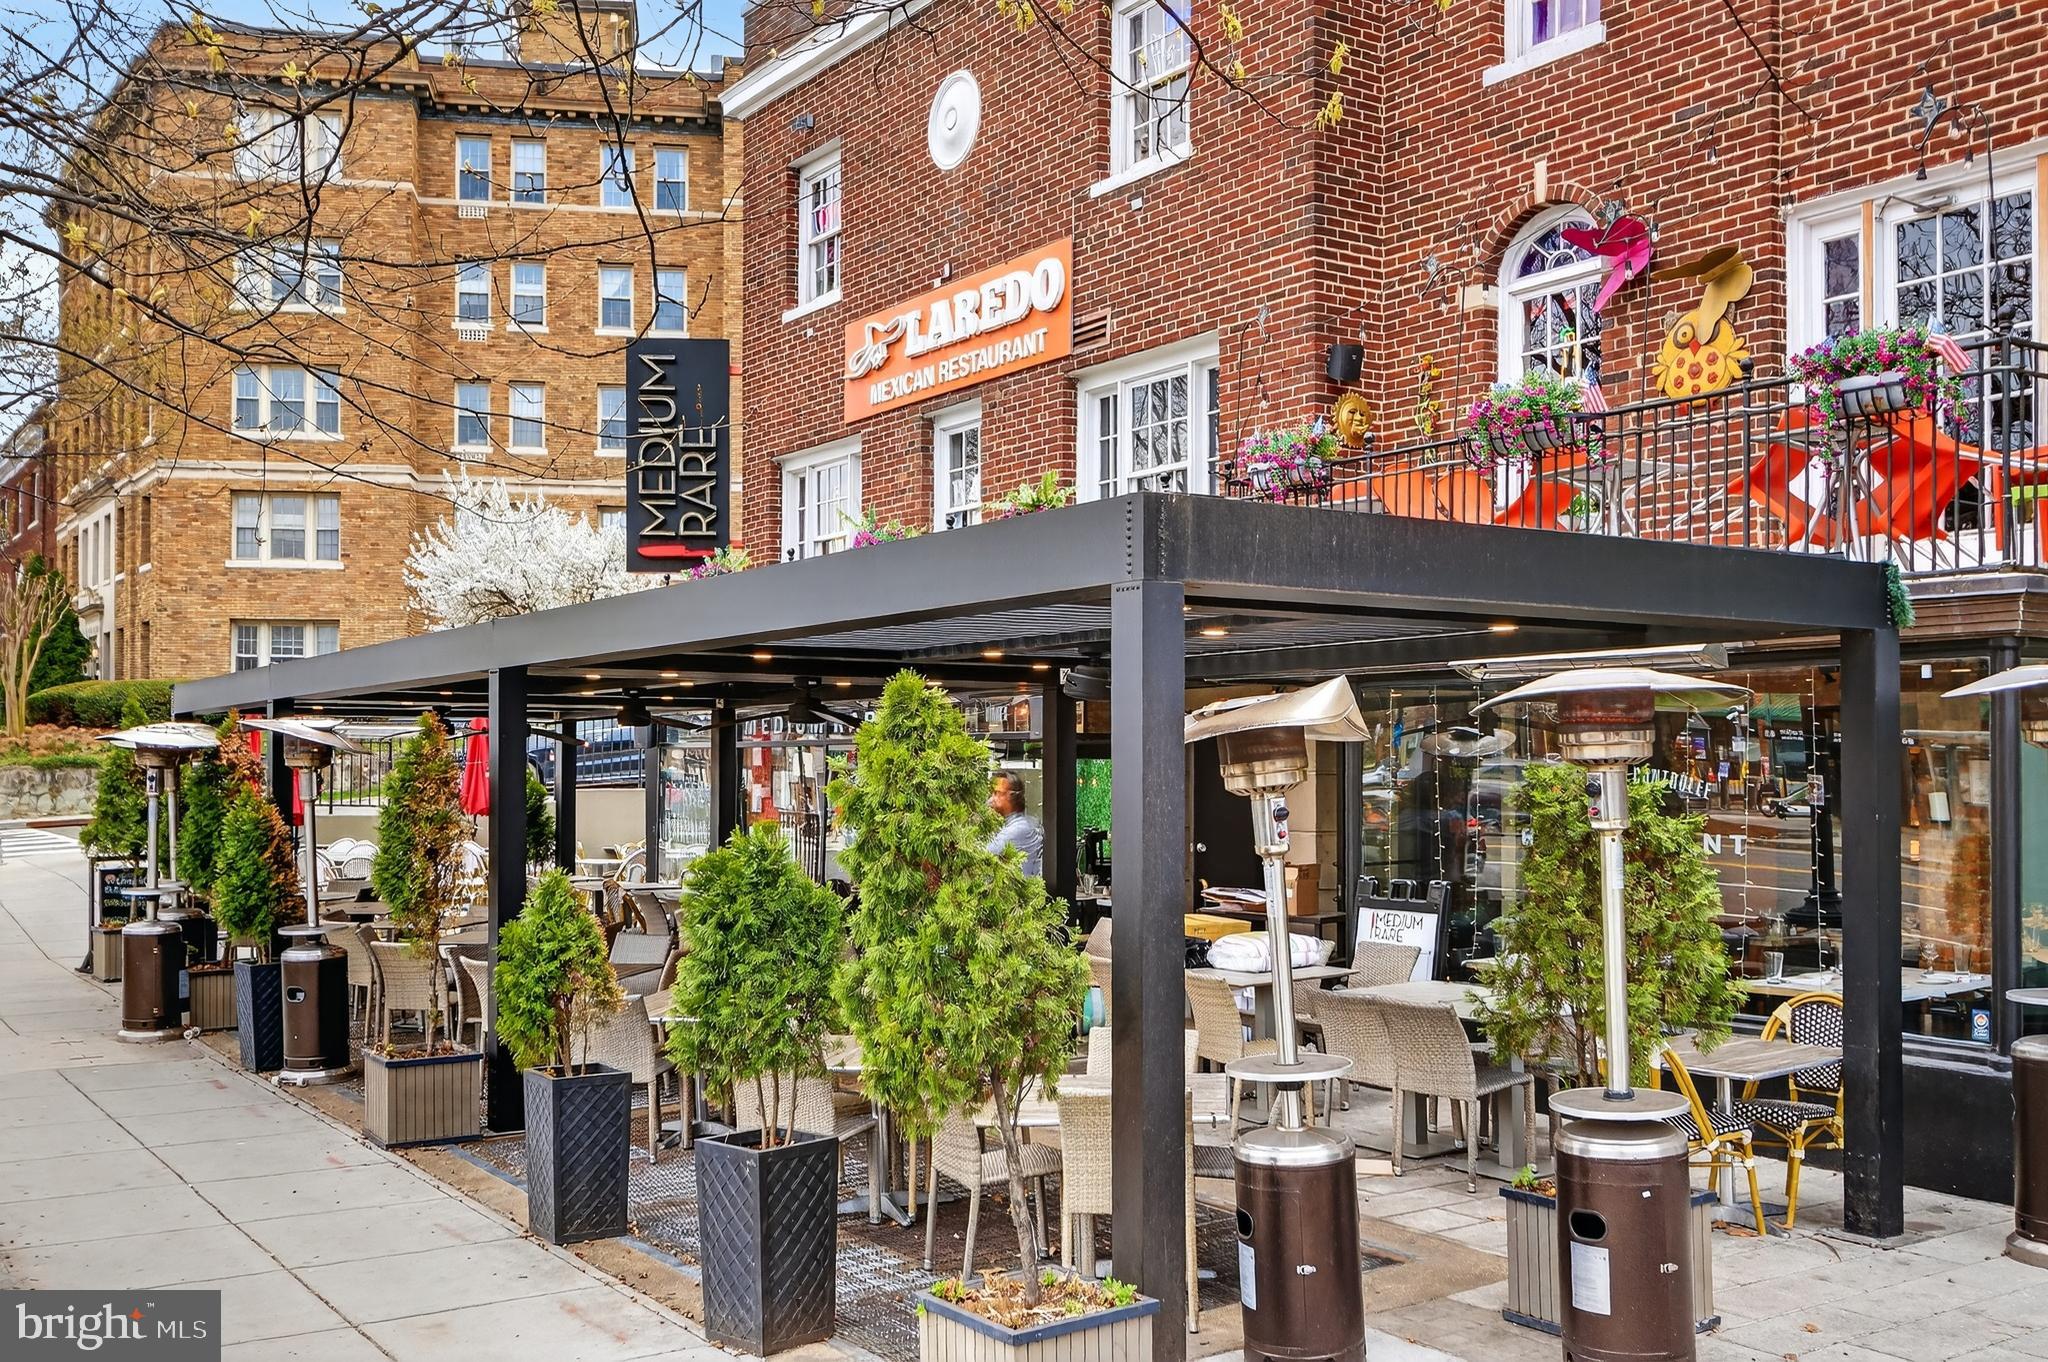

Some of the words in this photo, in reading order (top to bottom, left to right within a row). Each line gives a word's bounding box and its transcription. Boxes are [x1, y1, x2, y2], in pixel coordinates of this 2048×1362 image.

[904, 257, 1065, 359] LAREDO
[869, 364, 935, 405] MEXICAN
[938, 327, 1048, 383] RESTAURANT
[638, 354, 676, 536] MEDIUM
[679, 423, 717, 536] RARE
[1374, 927, 1405, 943] RARE
[1375, 912, 1424, 931] MEDIUM
